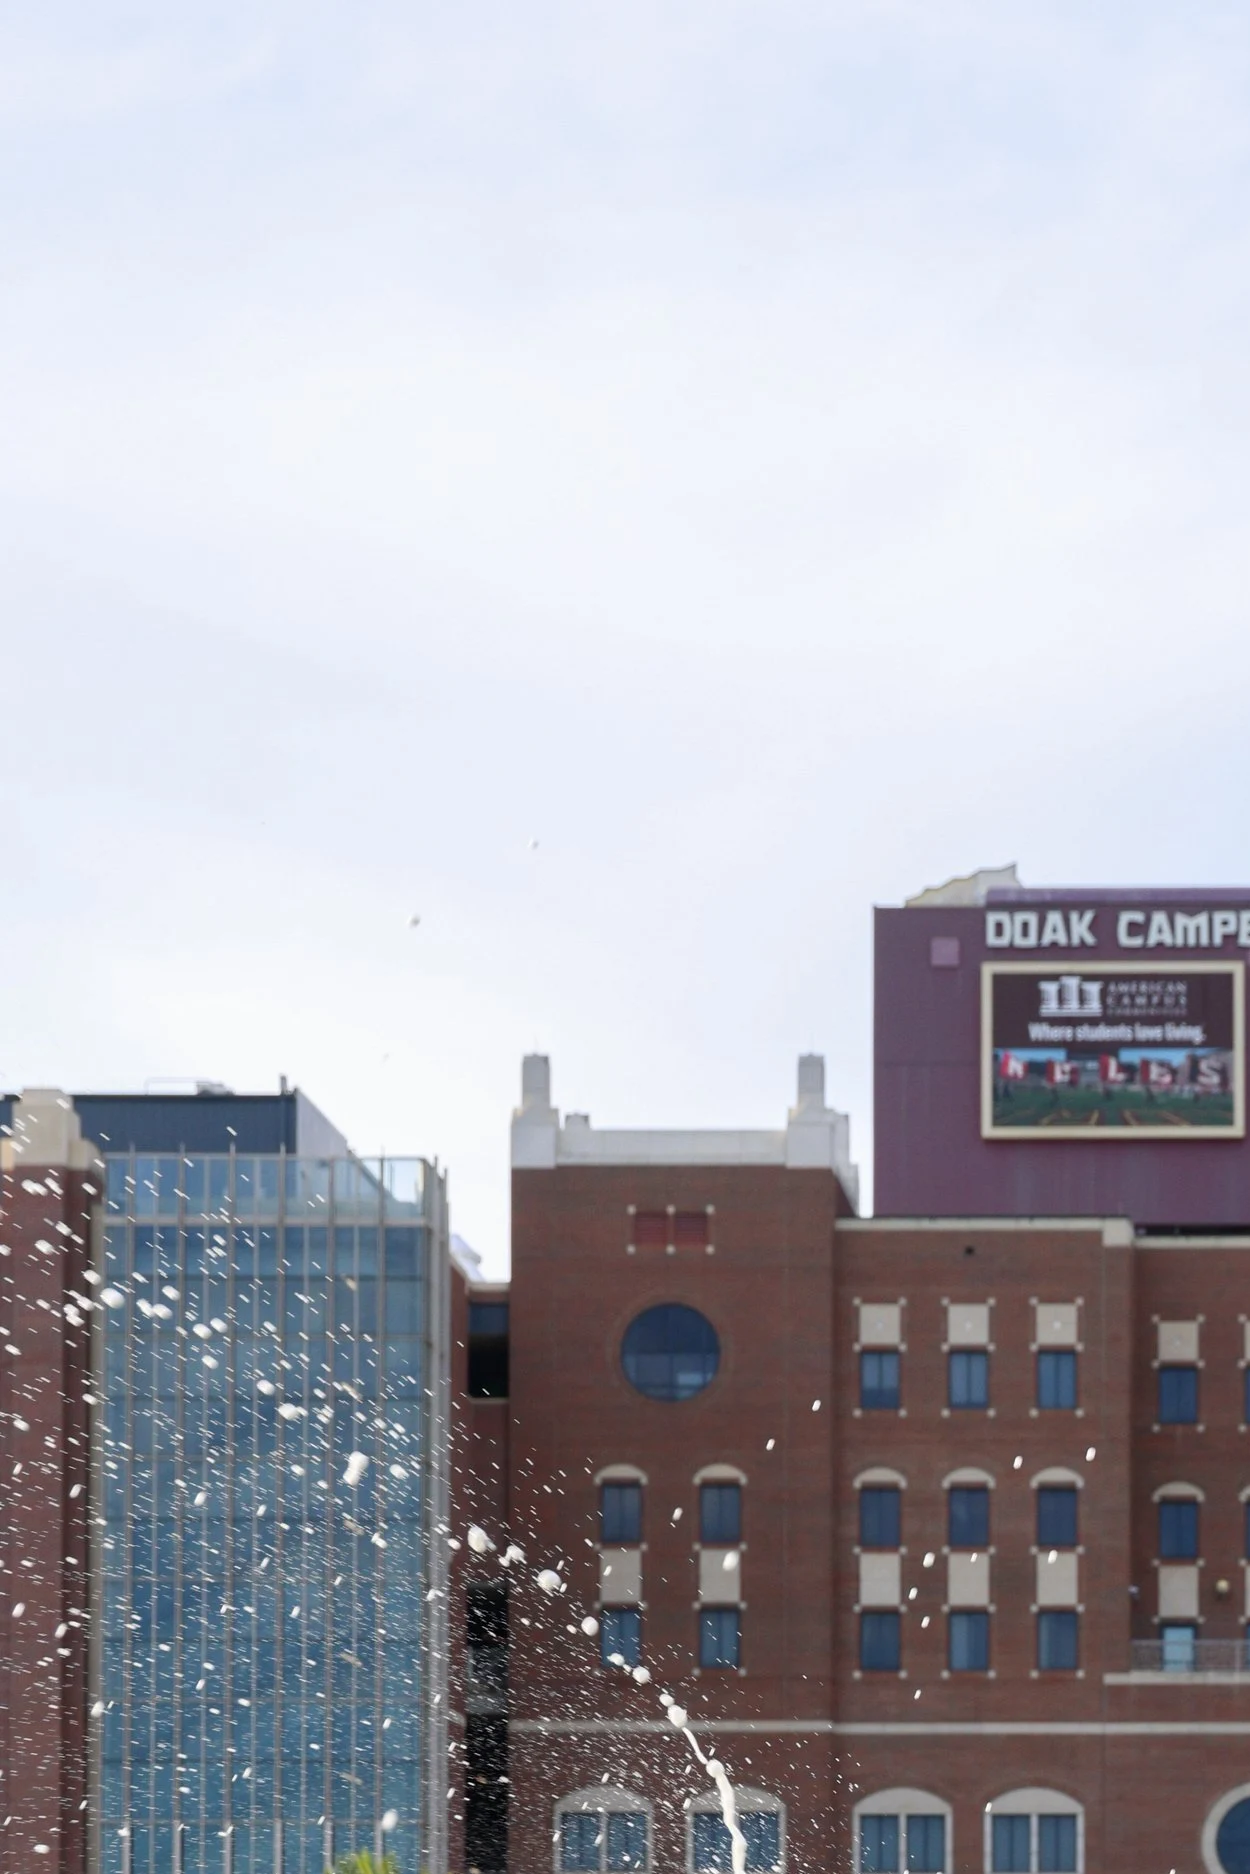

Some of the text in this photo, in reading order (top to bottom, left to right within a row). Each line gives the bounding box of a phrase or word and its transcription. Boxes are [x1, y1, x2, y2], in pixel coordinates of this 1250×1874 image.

[985, 910, 1097, 948] DOAK
[1028, 1022, 1074, 1042] Where
[1075, 1023, 1134, 1042] students
[1134, 1022, 1163, 1042] love
